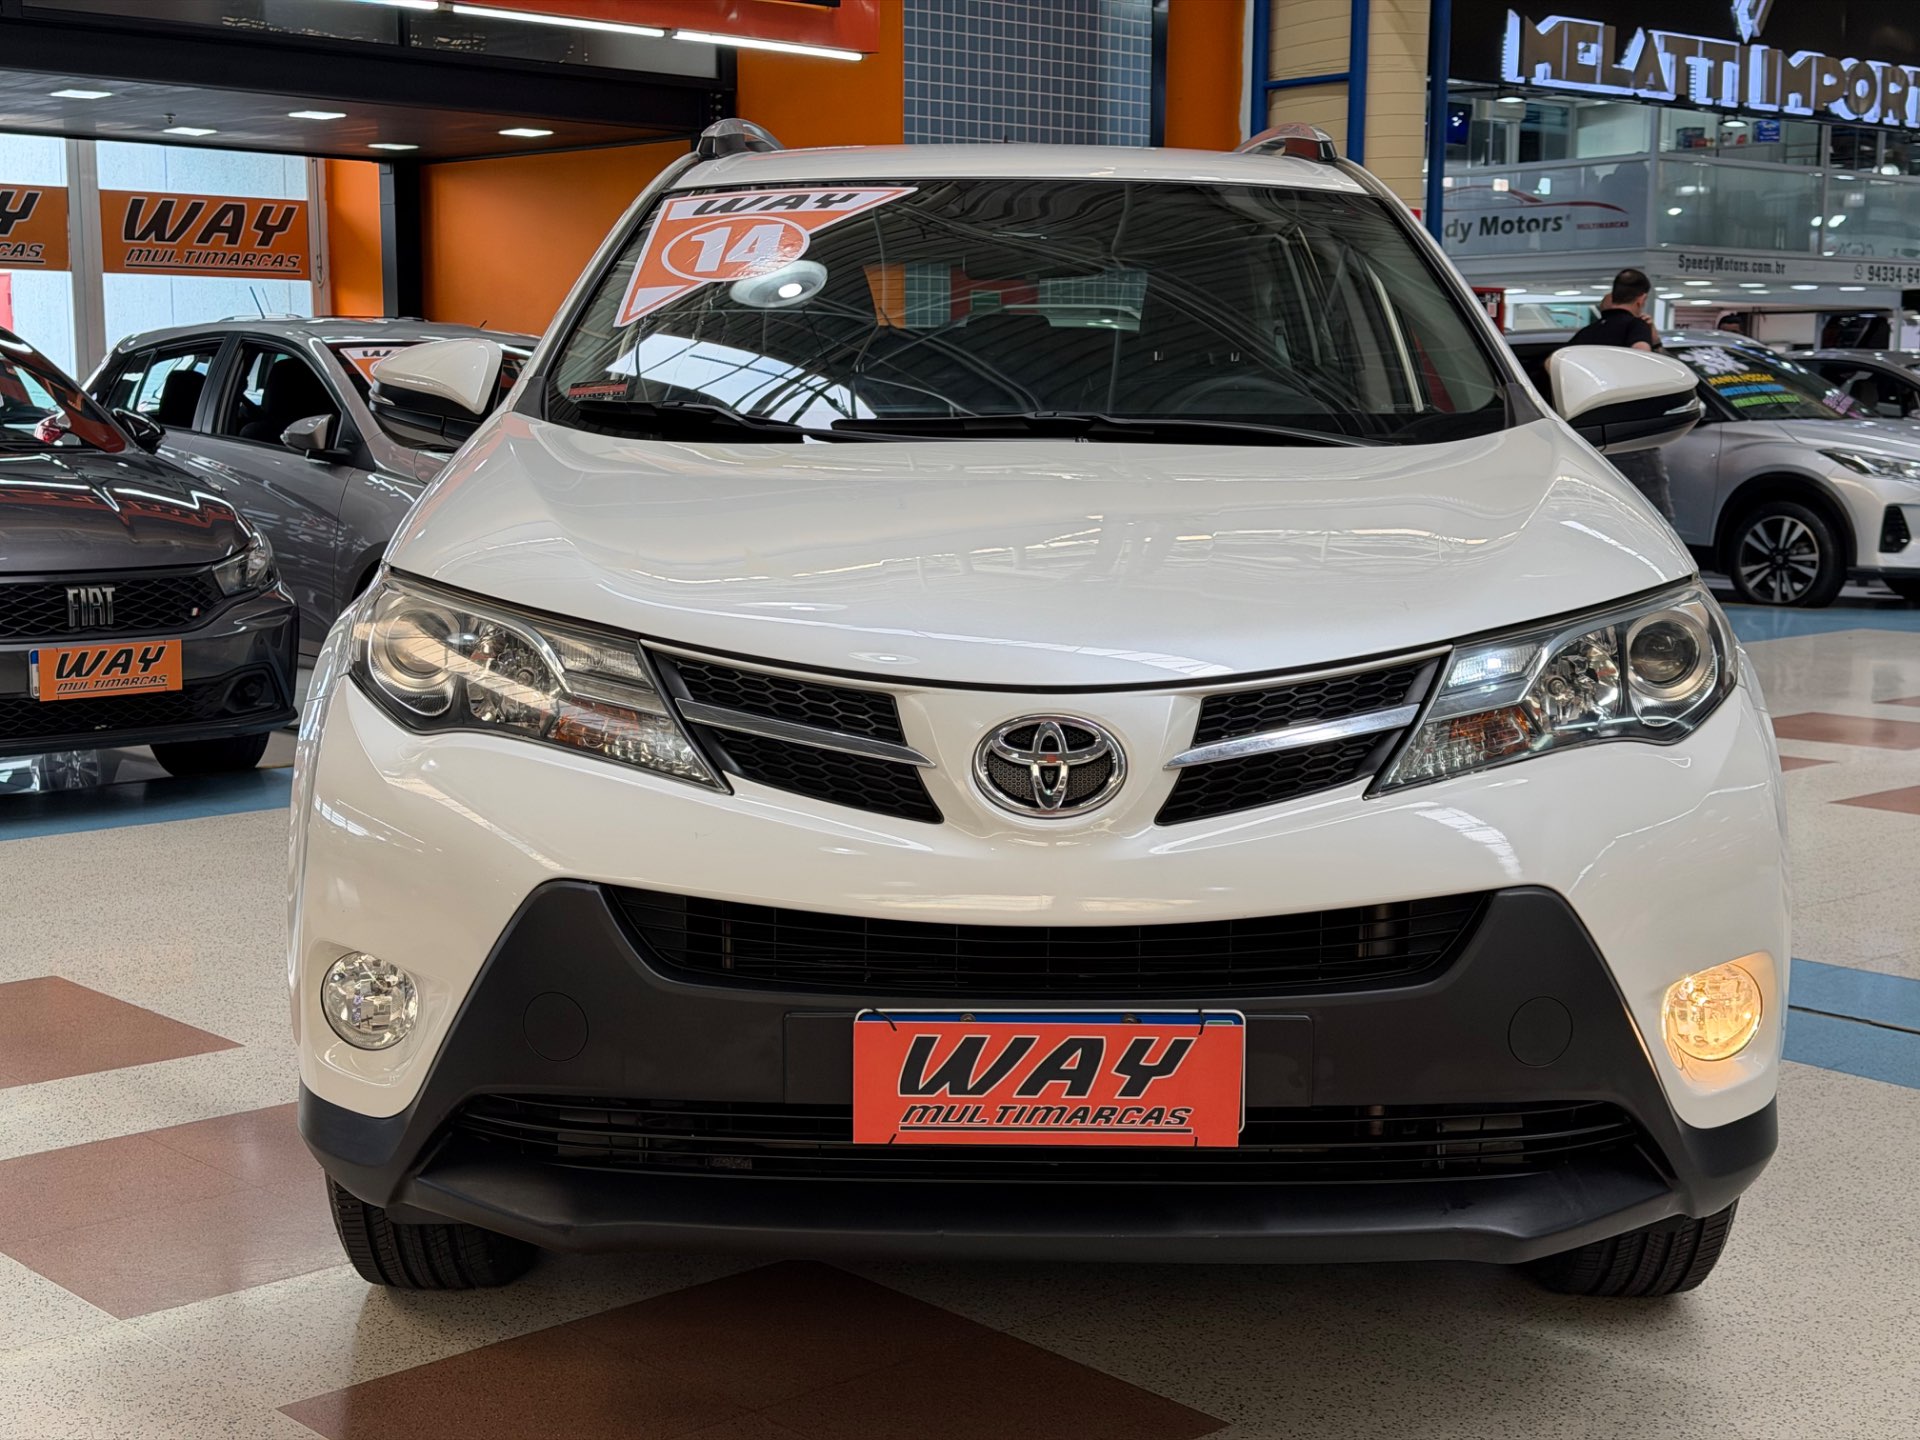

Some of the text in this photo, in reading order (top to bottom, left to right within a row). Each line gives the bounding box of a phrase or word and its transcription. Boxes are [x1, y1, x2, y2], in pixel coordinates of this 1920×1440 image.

[1502, 9, 1752, 108] MELATTI
[692, 193, 861, 216] WAY
[122, 196, 299, 248] WAY
[1479, 214, 1563, 236] Motors
[125, 247, 301, 269] MULTIMARCAS
[690, 223, 786, 273] 14
[1678, 254, 1786, 276] SpeedyMotors.com.br
[66, 587, 116, 628] FIAT
[56, 645, 168, 680] WAY
[57, 674, 168, 692] MULTIMARCAS
[898, 1034, 1198, 1099] WAY
[899, 1103, 1194, 1126] MULTIMARCAS
